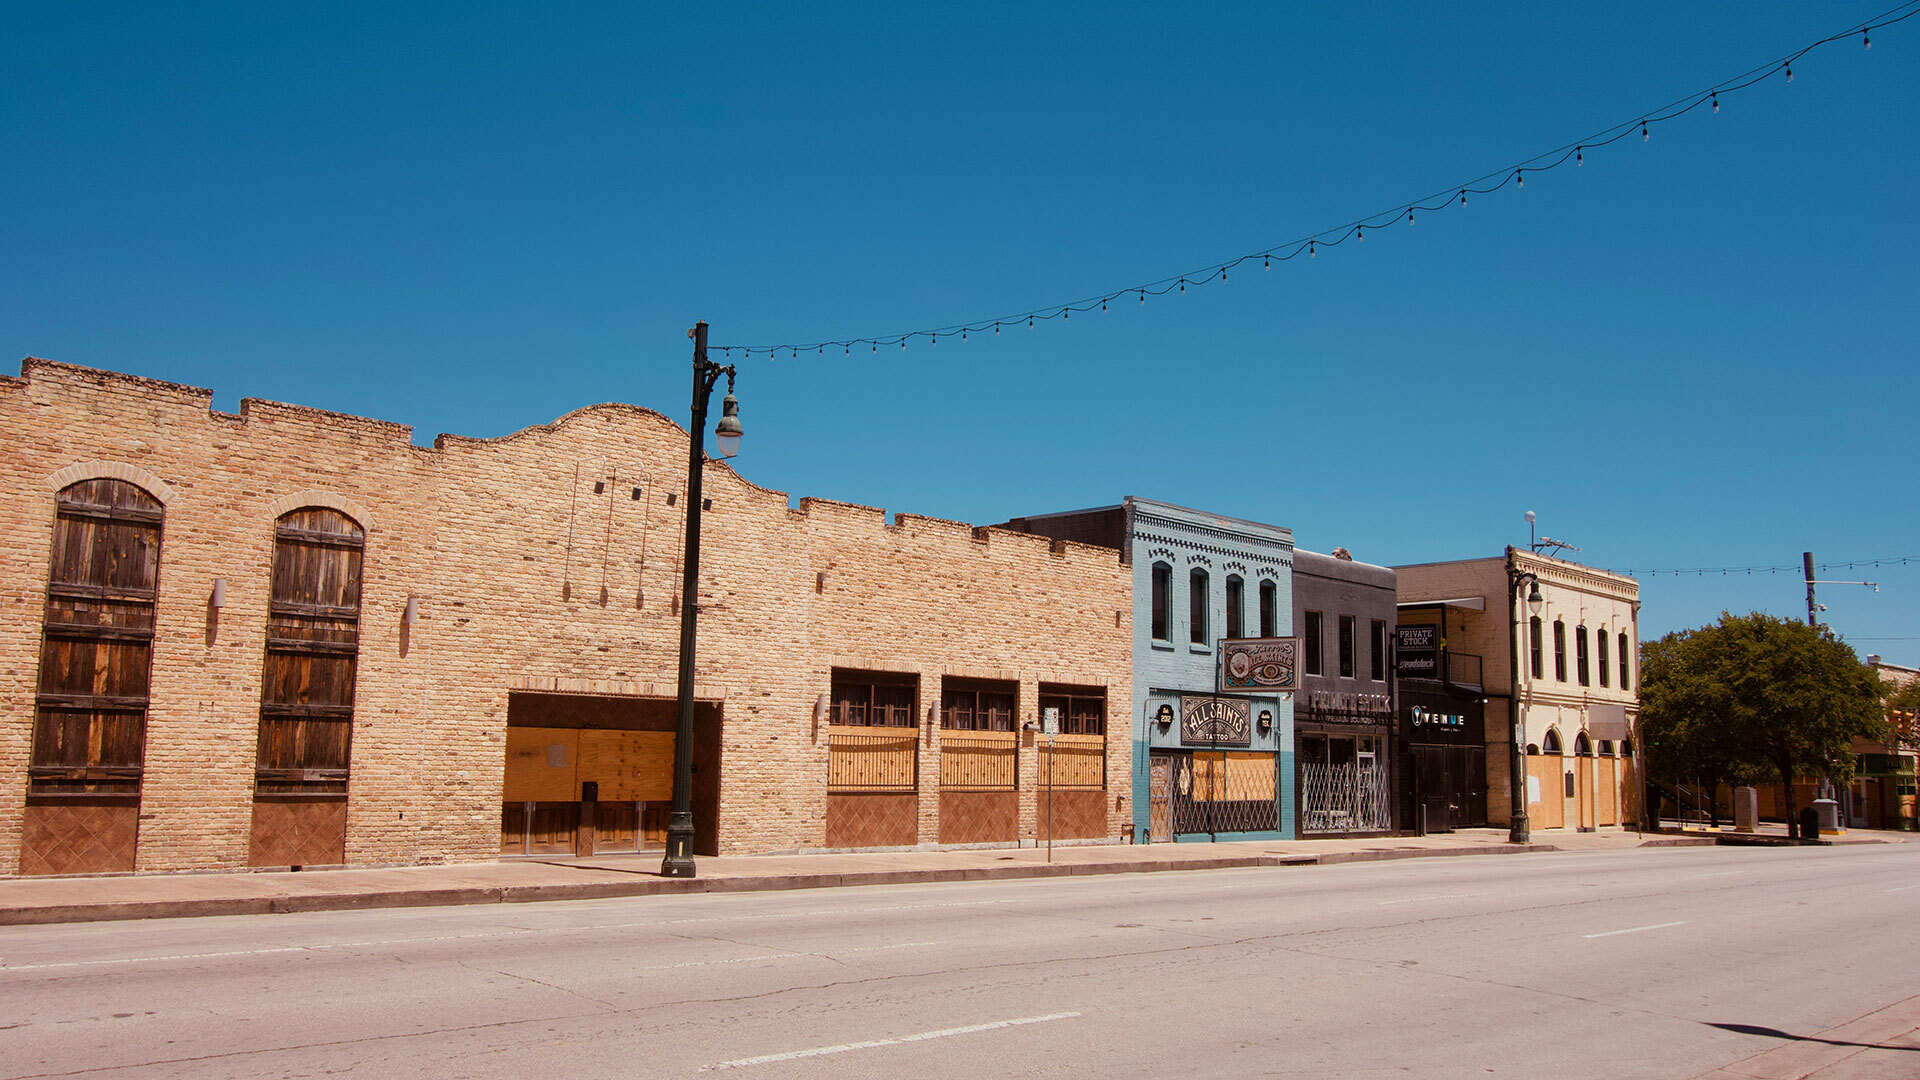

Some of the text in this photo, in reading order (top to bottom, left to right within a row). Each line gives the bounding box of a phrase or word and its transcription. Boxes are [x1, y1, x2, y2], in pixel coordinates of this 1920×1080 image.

[1400, 630, 1432, 638] PRIVATE
[1403, 637, 1428, 645] STOCK
[1311, 690, 1391, 713] PRIVATE STOCK
[1190, 702, 1244, 732] ALL SAINTS
[1422, 713, 1464, 725] VENUE
